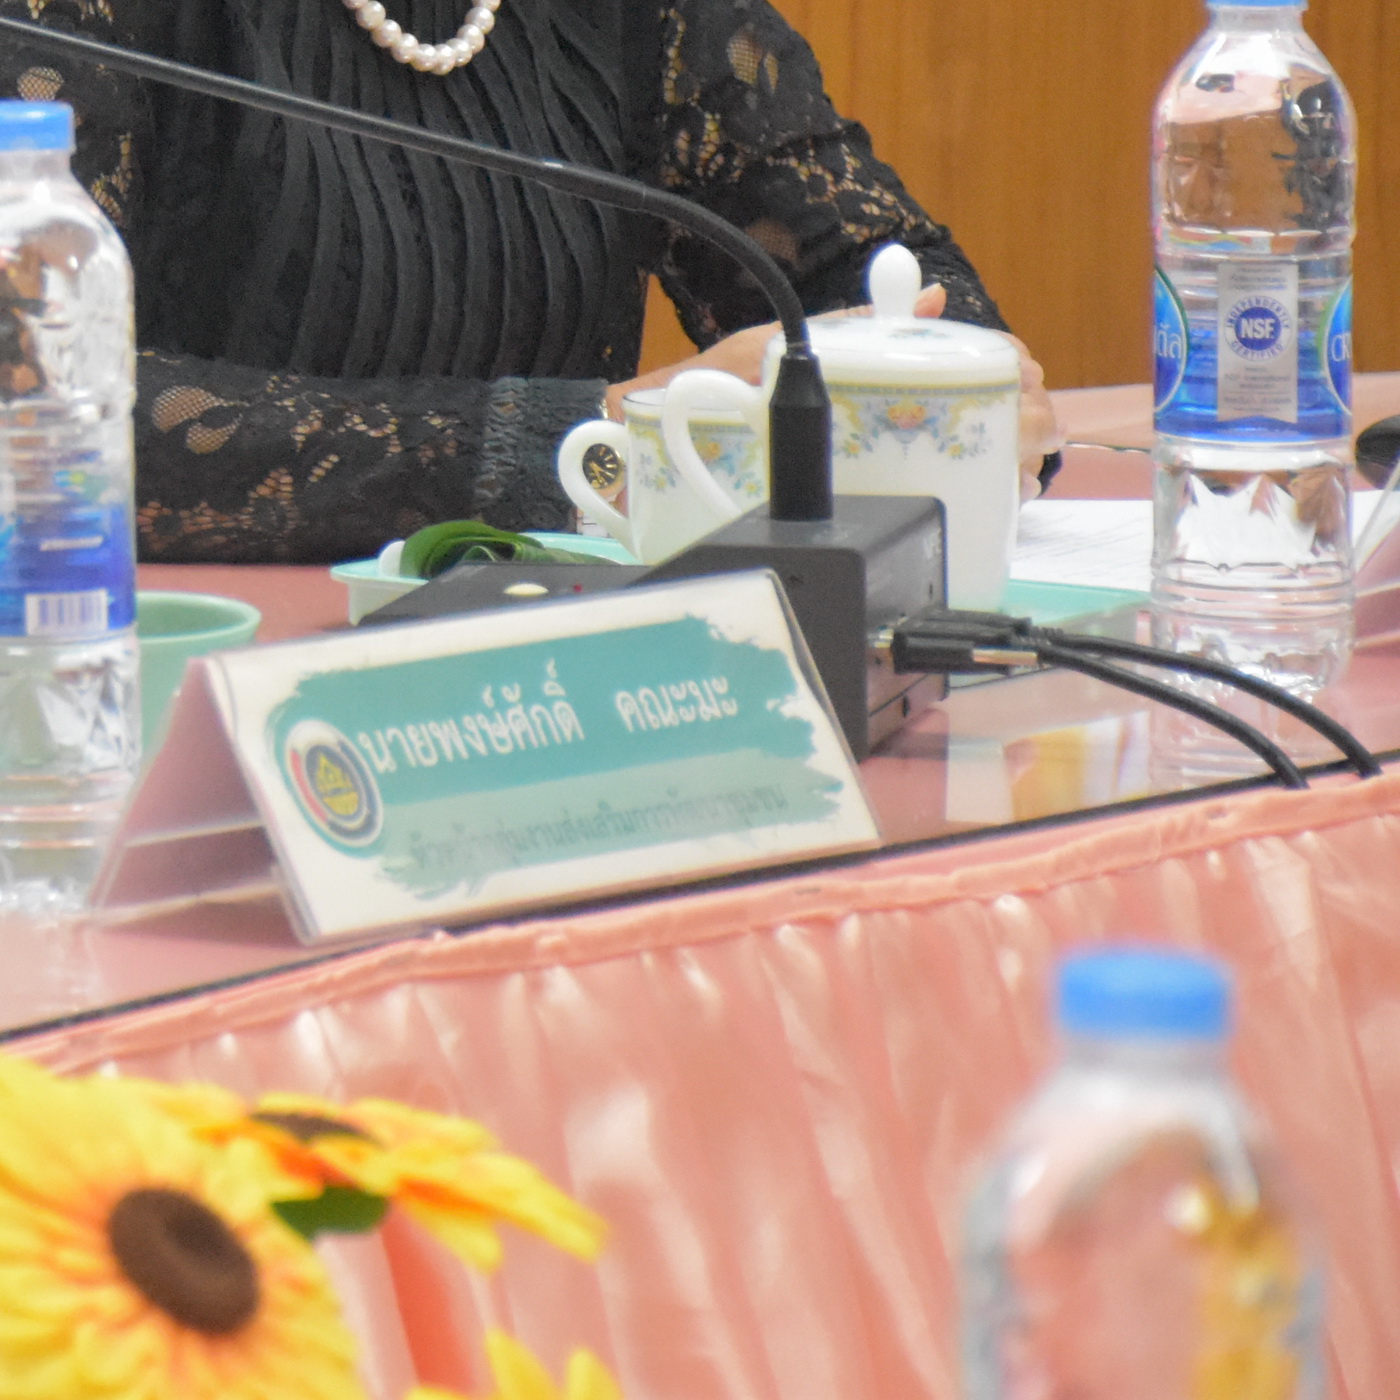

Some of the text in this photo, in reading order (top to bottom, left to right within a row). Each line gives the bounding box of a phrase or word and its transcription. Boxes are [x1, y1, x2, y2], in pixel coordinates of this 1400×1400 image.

[1241, 317, 1276, 339] NSF
[357, 658, 740, 774] นายพงษ์ศักดิ์ คณะมะ
